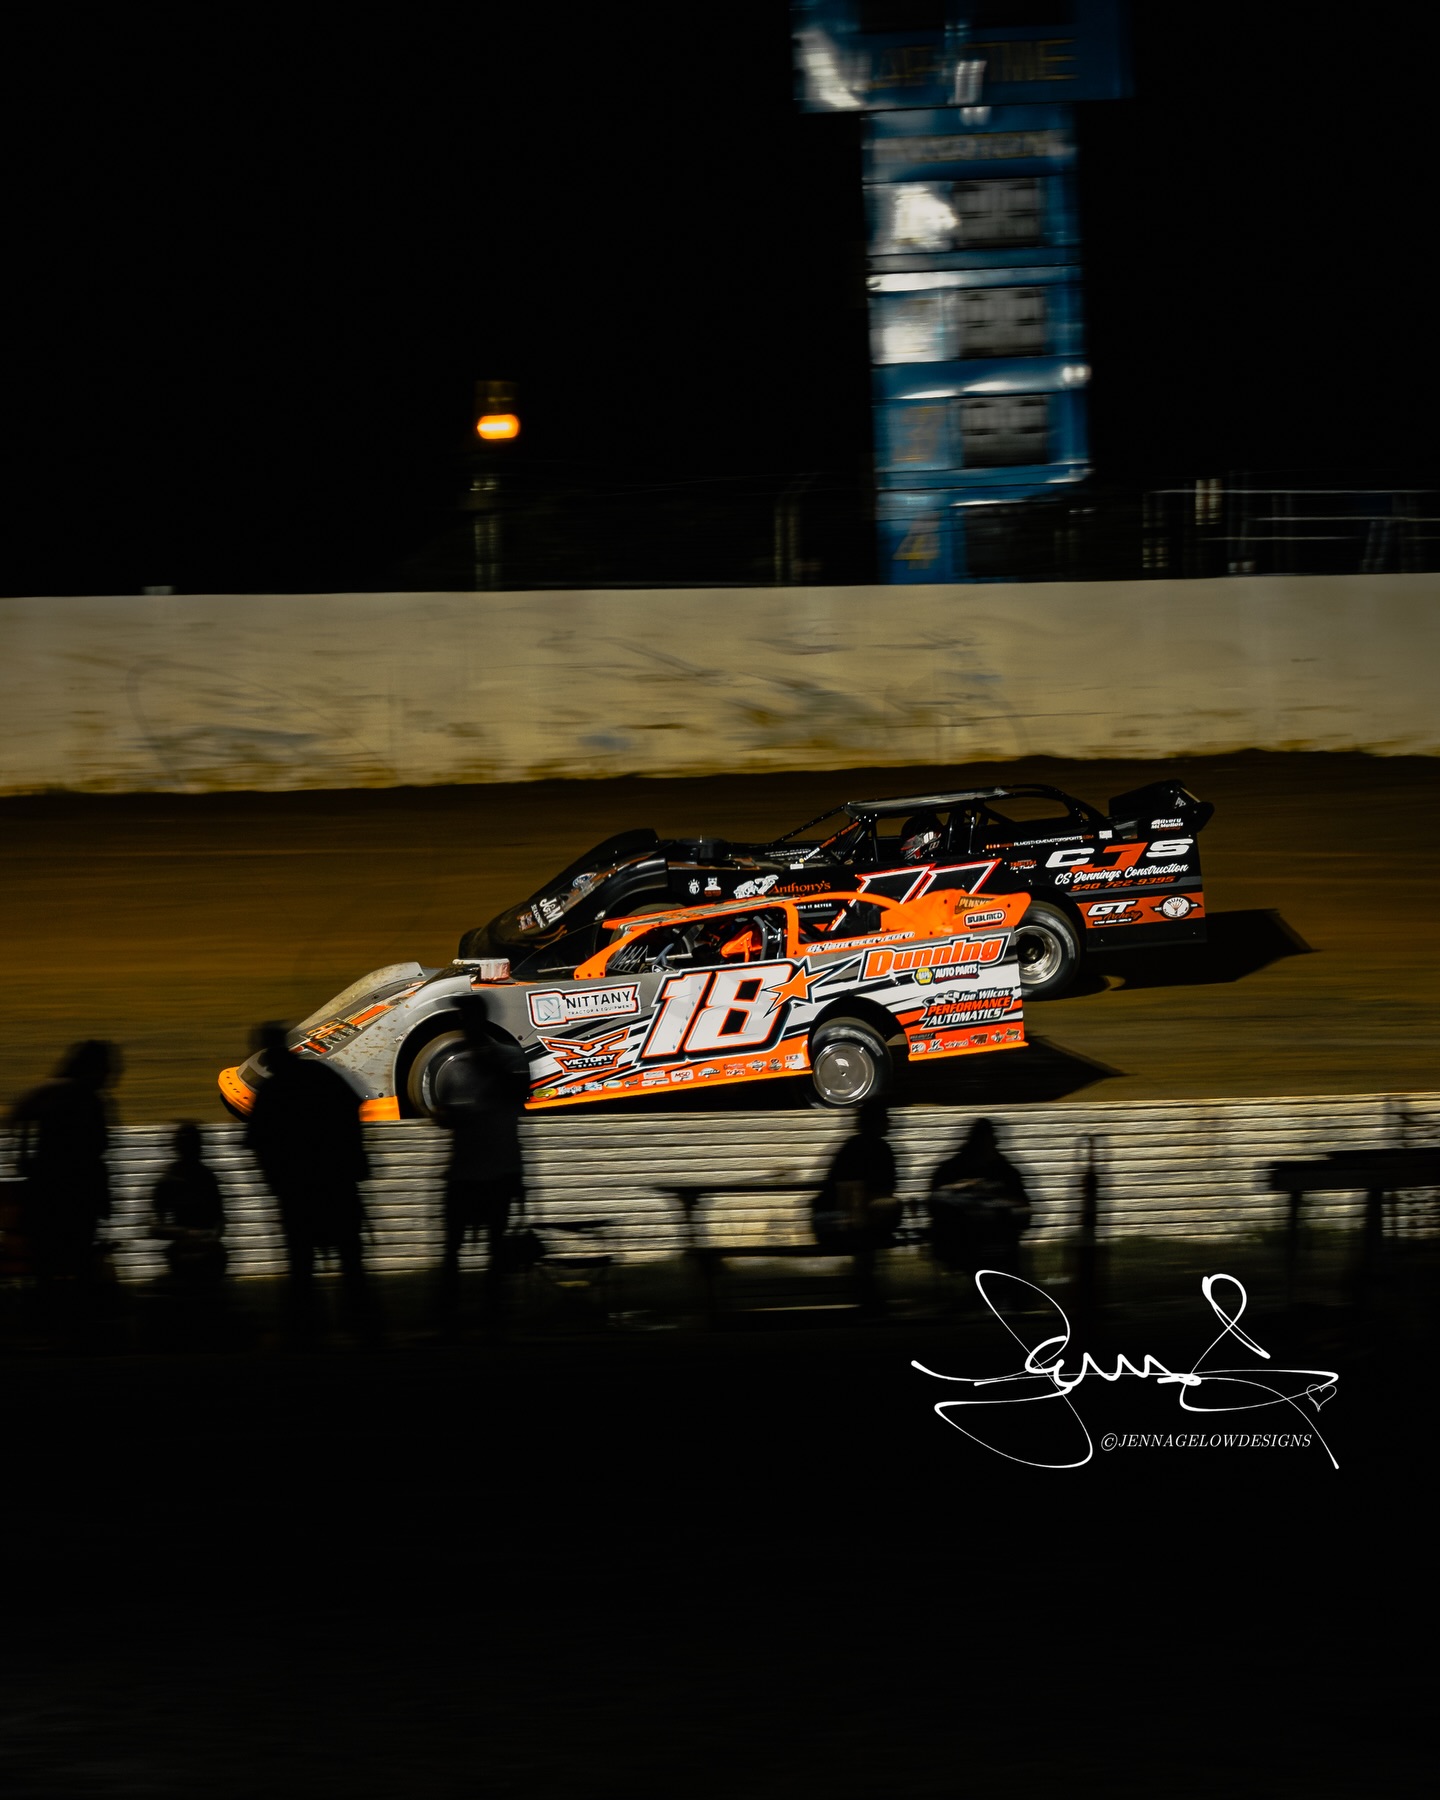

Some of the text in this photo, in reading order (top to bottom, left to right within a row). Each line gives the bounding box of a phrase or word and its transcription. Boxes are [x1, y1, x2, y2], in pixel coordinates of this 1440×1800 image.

[1055, 862, 1189, 886] CS Jennings Construction
[767, 880, 831, 896] Anthony's
[1087, 900, 1137, 917] GT
[864, 939, 1002, 979] Dunning
[935, 968, 954, 979] AUTO
[954, 965, 978, 978] PARTS
[565, 990, 631, 1009] NITTANY
[958, 987, 1012, 1003] Joe Wilcox
[568, 1008, 594, 1016] TRACTOR
[600, 1003, 633, 1013] EQUIPMENT
[641, 964, 792, 1057] 18
[928, 997, 1012, 1017] PERFORMANCE
[928, 1009, 1002, 1027] AUTOMATICS
[563, 1054, 616, 1067] VICTORY
